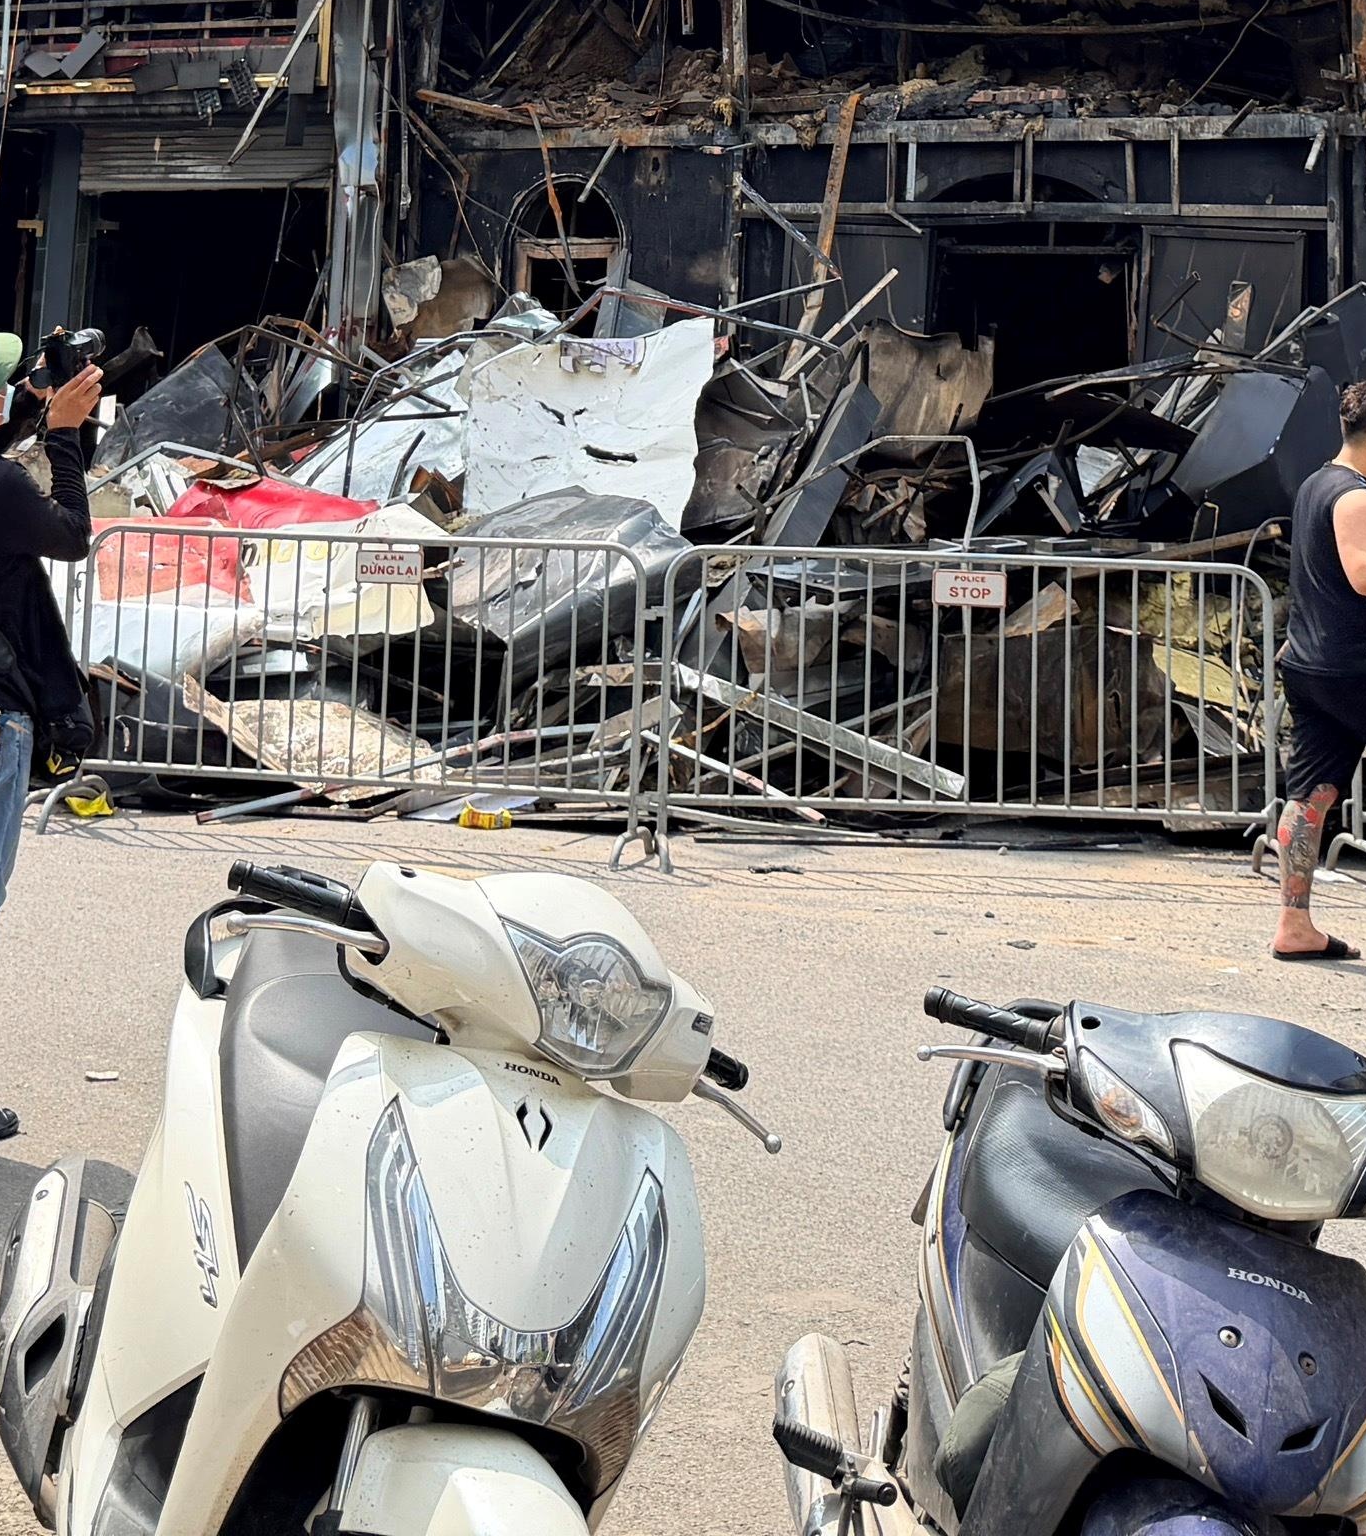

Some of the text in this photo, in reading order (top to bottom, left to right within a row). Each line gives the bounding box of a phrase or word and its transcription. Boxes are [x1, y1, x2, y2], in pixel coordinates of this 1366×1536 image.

[360, 561, 418, 579] DỪNG LẠI
[954, 575, 987, 583] POLICE
[949, 586, 992, 600] STOP
[504, 1061, 562, 1087] HONDA
[1227, 1267, 1314, 1305] HONDA
